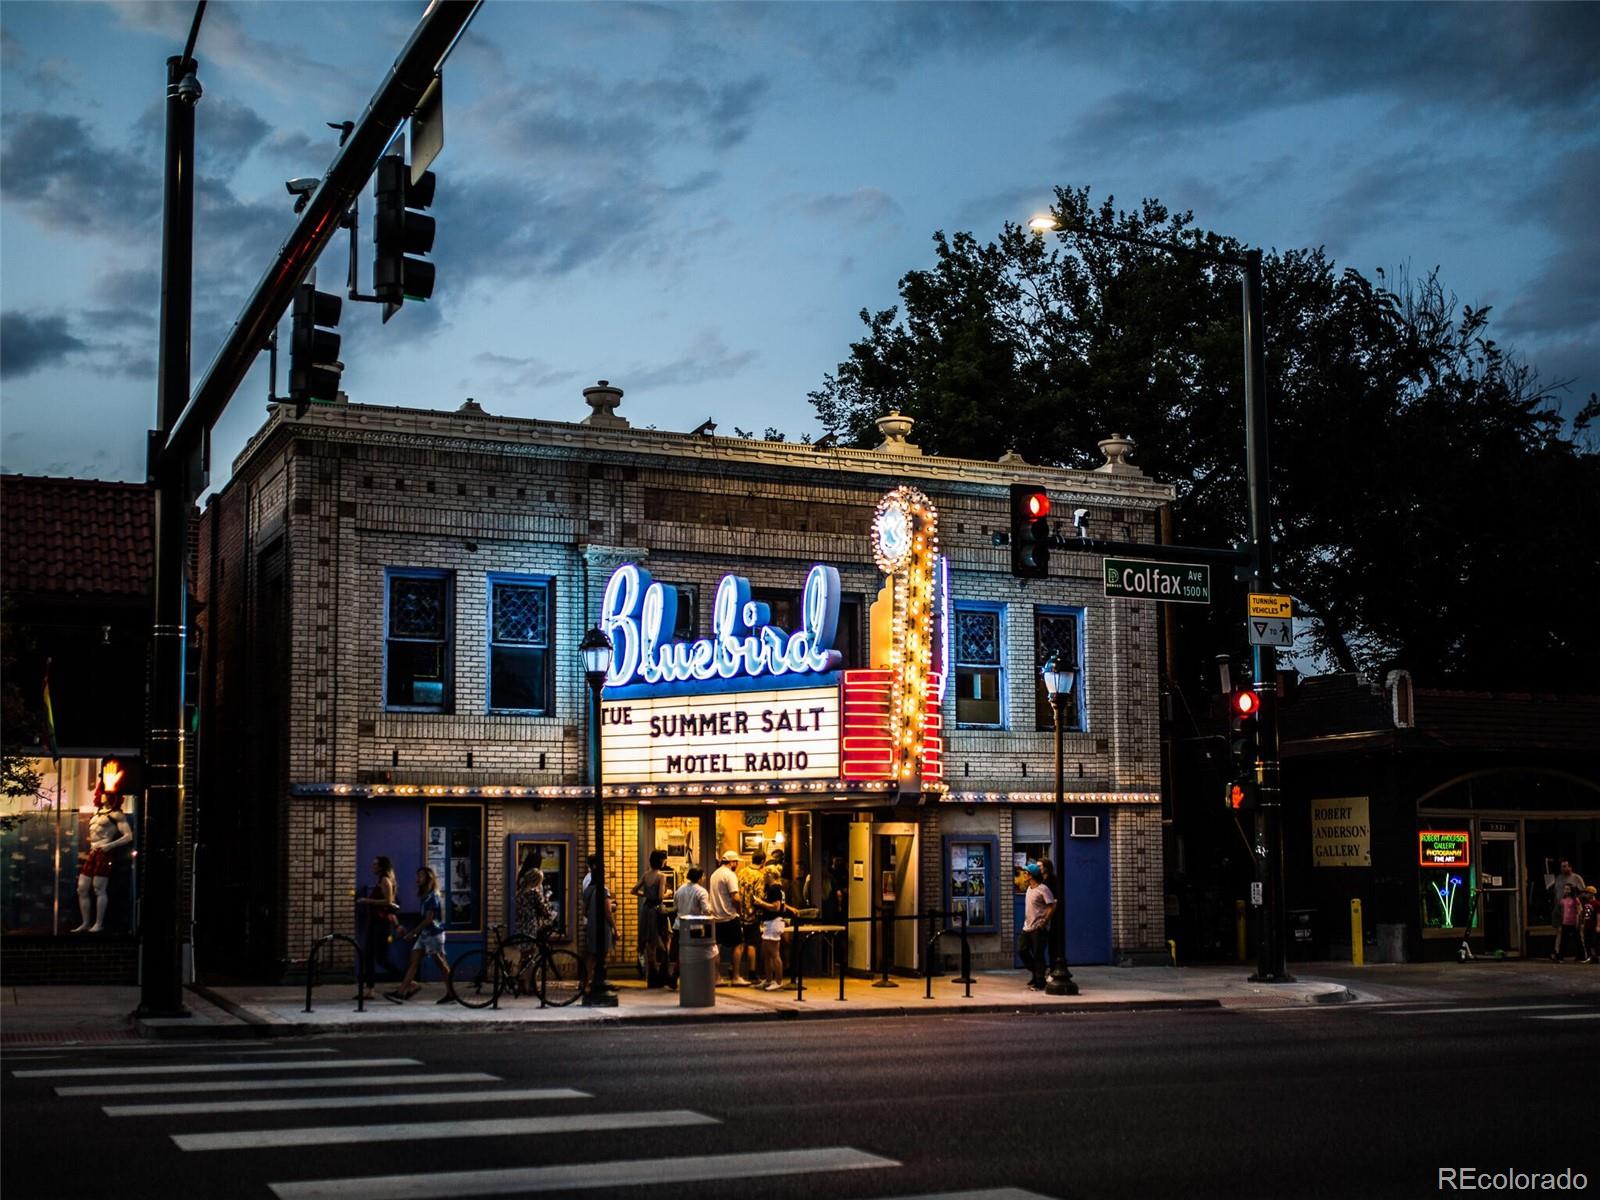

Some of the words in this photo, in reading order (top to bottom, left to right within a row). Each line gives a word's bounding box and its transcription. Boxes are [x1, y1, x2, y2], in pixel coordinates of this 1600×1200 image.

[1122, 568, 1182, 595] Colfax
[1187, 570, 1203, 582] Ave
[1183, 586, 1201, 598] 1500
[1202, 587, 1208, 598] N
[1252, 597, 1278, 605] TURNING
[600, 563, 841, 687] Bluebird
[1269, 628, 1278, 636] TO
[601, 706, 633, 726] TUE
[649, 710, 750, 738] SUMMER
[760, 706, 825, 733] SALT
[666, 753, 734, 774] MOTEL
[745, 751, 809, 773] RADIO
[1314, 807, 1352, 820] ROBERT
[1314, 825, 1367, 839] ANDERSON
[1314, 844, 1361, 857] GALLERY
